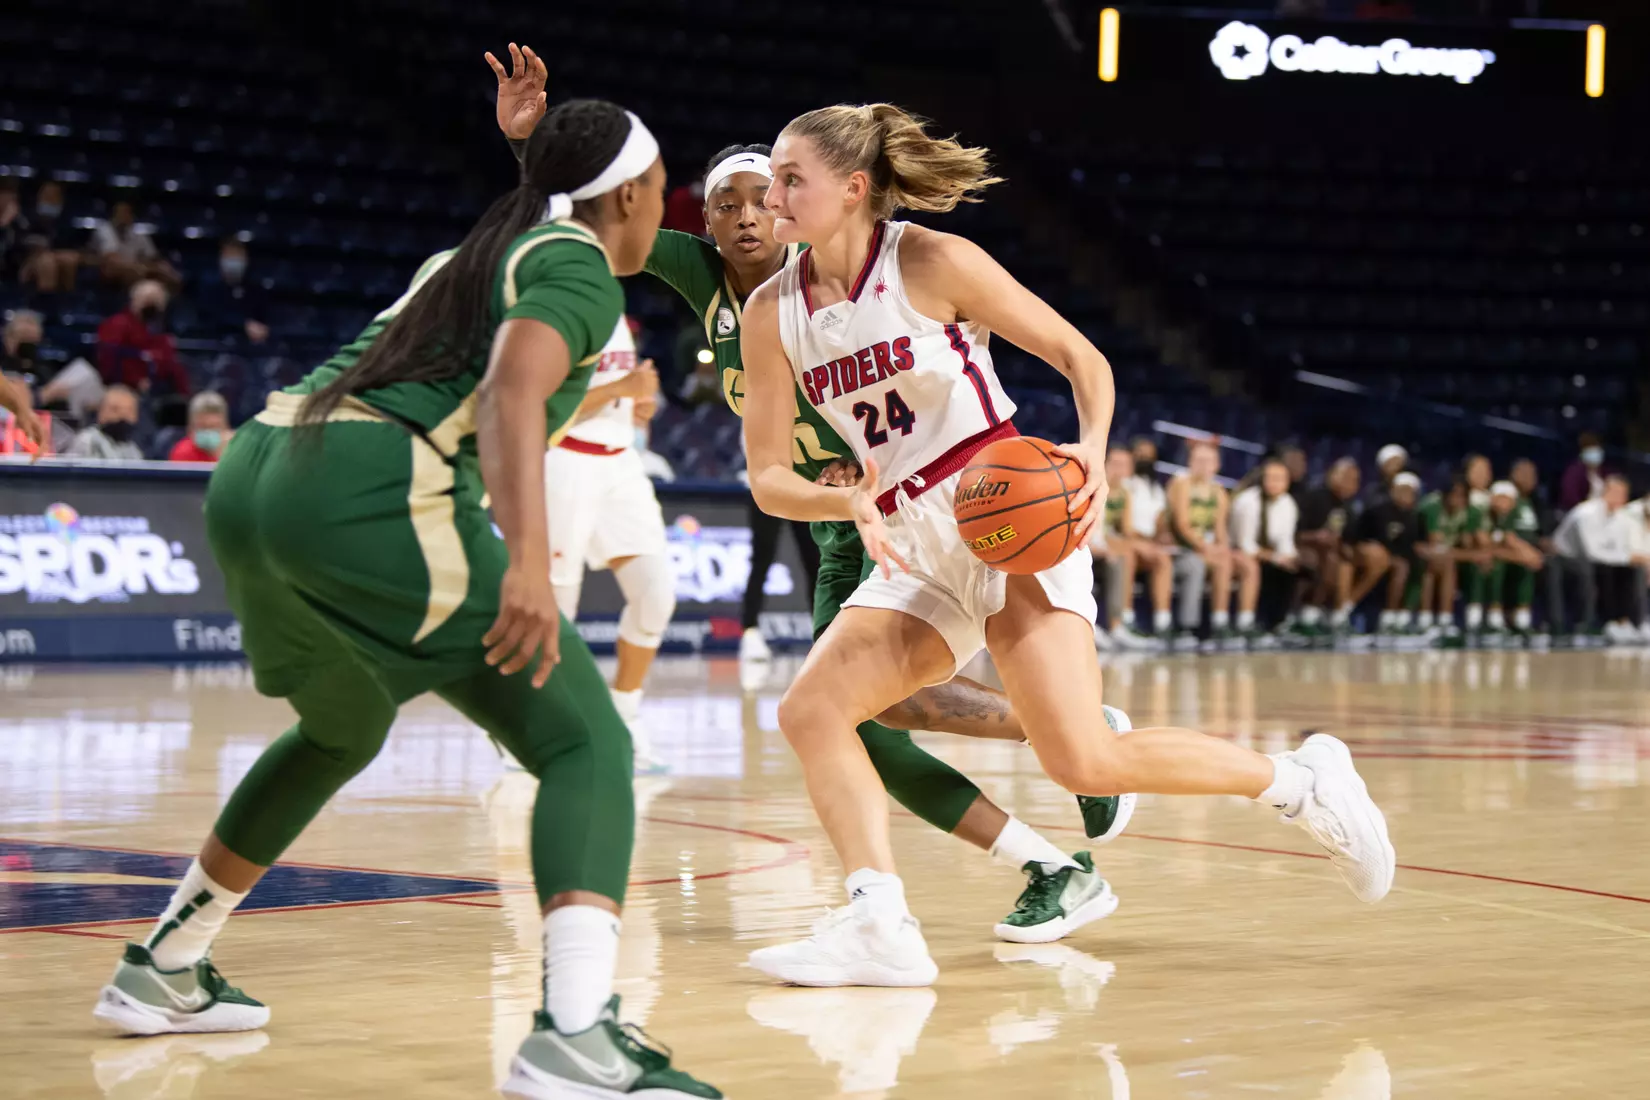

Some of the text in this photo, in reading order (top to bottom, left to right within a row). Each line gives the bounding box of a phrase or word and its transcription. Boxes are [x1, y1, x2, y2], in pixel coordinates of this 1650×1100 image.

[819, 316, 844, 331] adidas
[802, 335, 914, 407] SPIDERS
[852, 388, 916, 449] 24
[956, 473, 1011, 504] aden
[963, 525, 1018, 550] ELITE
